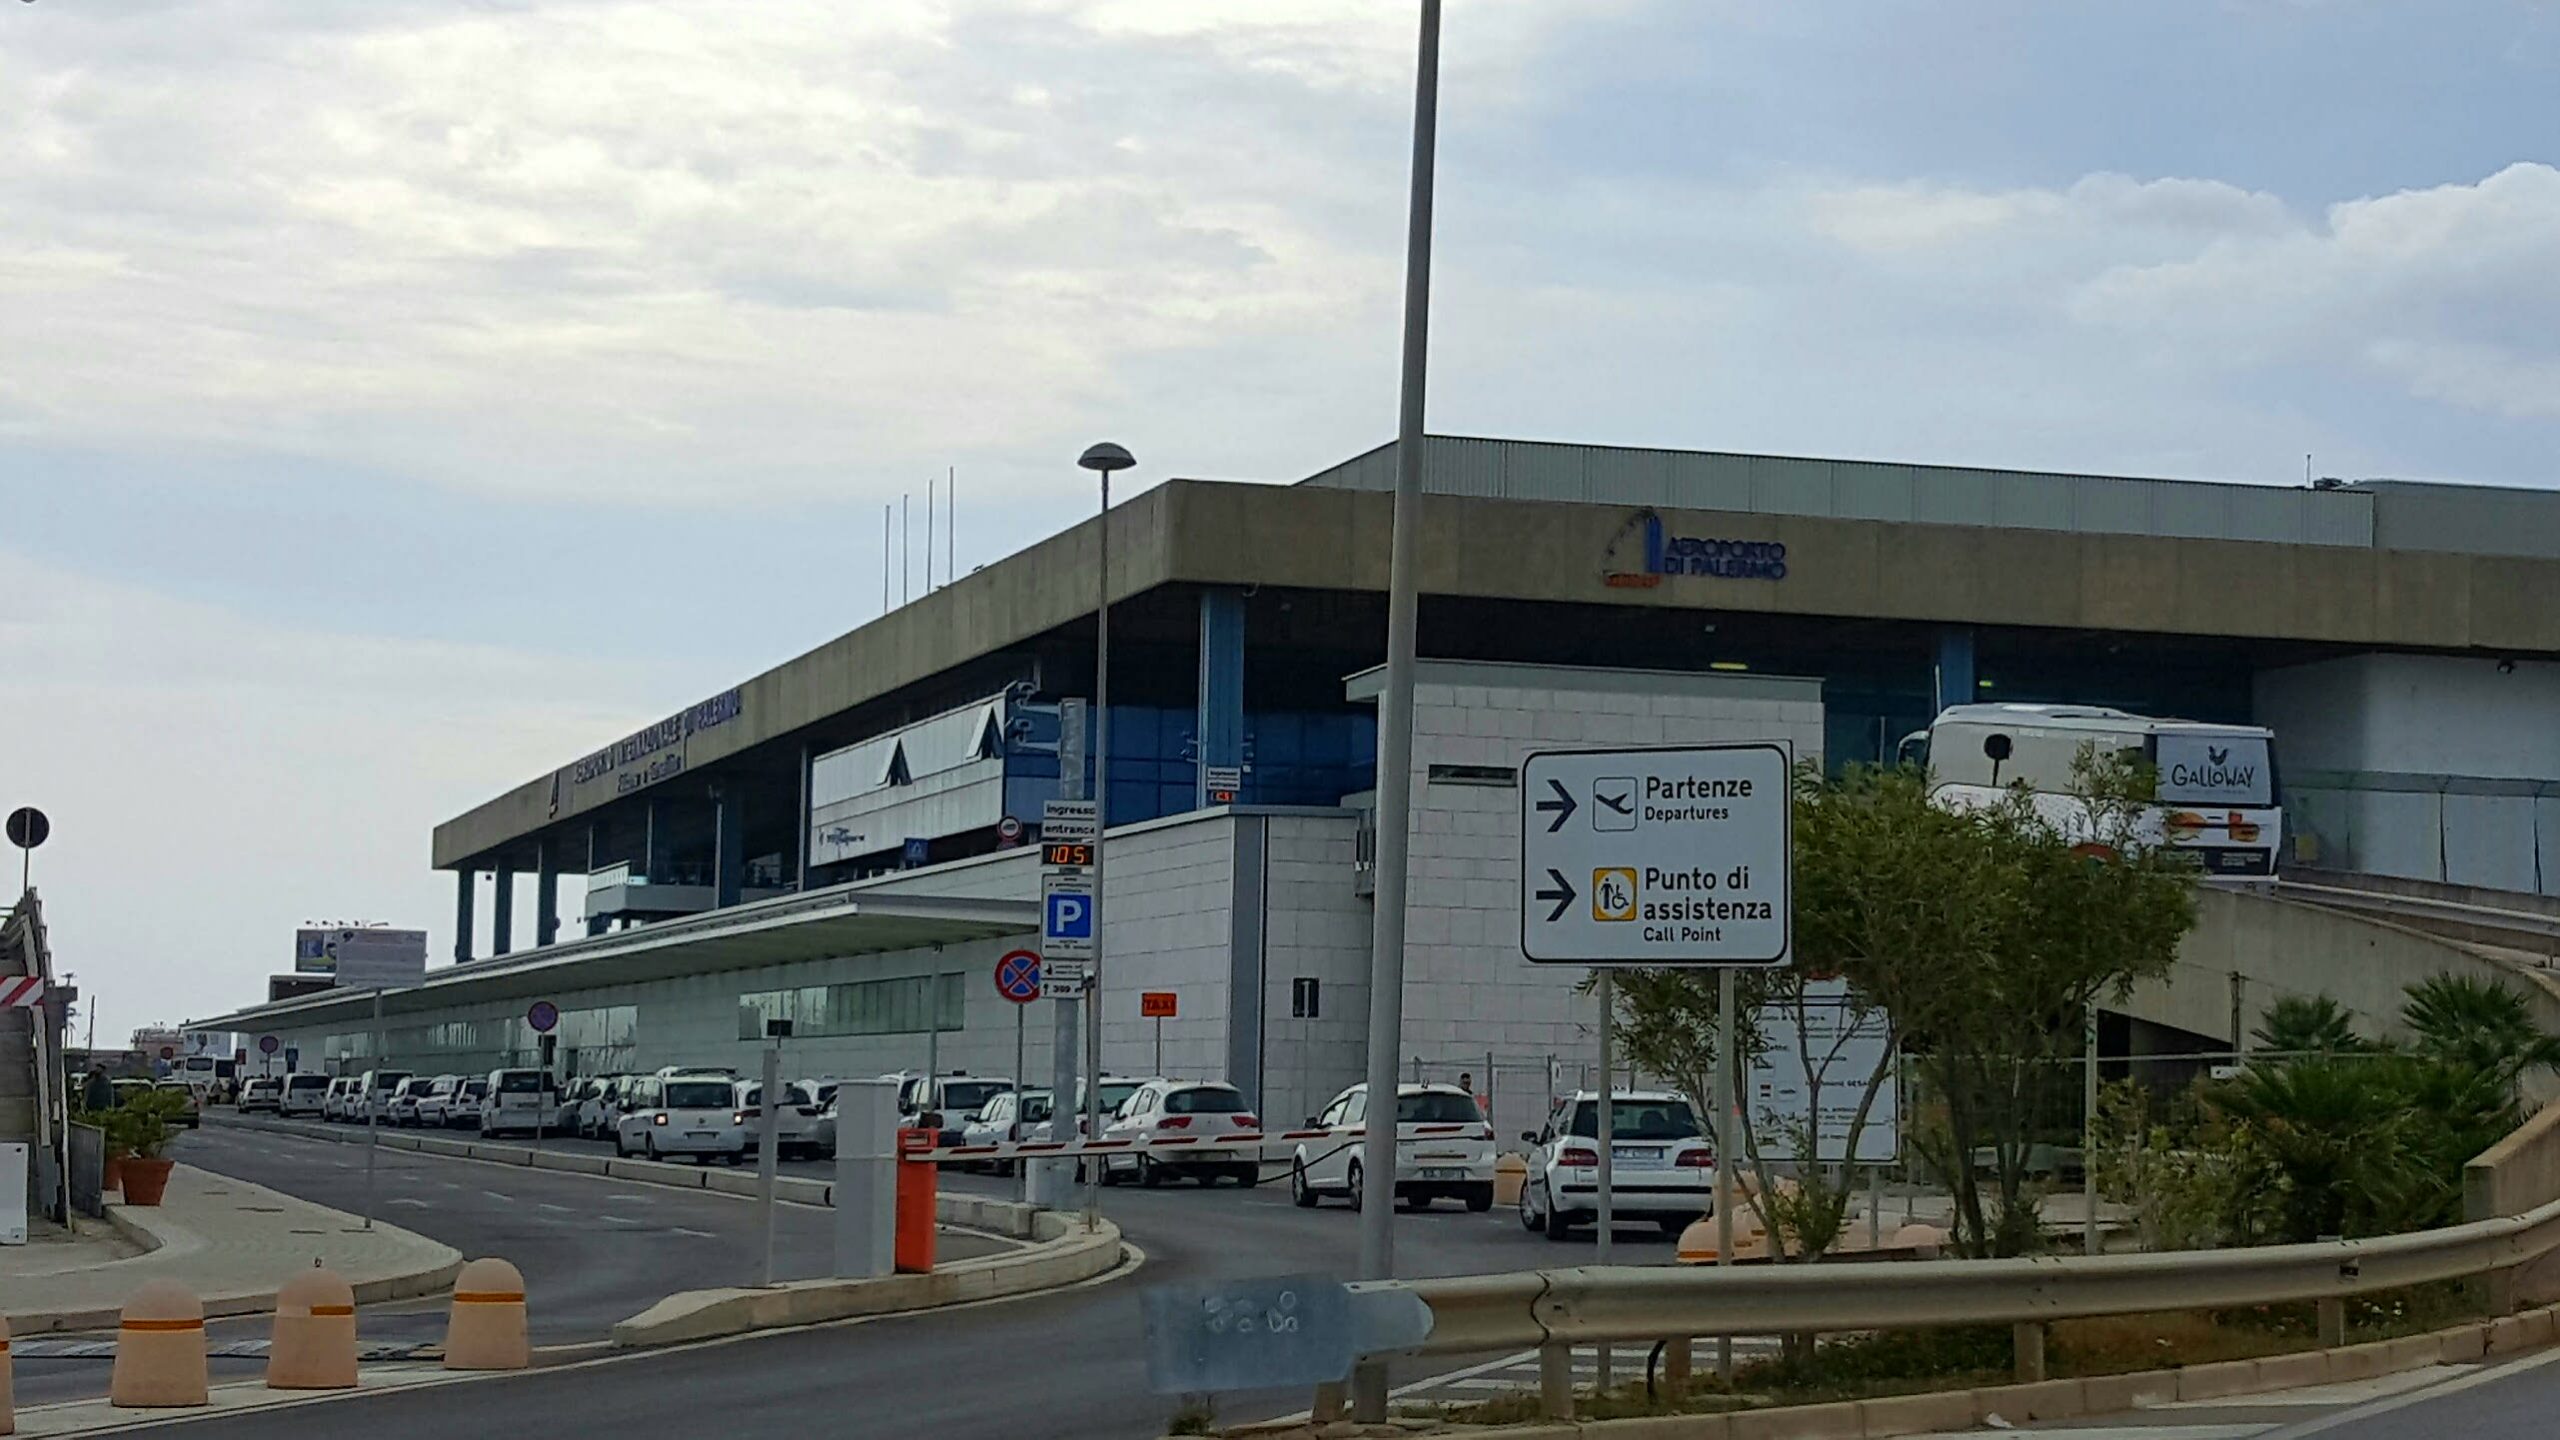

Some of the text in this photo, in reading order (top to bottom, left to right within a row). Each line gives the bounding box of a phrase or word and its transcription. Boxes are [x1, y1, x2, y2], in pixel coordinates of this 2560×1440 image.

[1646, 776, 1753, 799] Partenze
[2171, 764, 2255, 788] GALLOWAY
[1645, 806, 1729, 823] Departures
[1645, 867, 1749, 890] Punto di
[1056, 900, 1082, 933] P
[1644, 897, 1772, 920] assistenza
[1644, 926, 1721, 942] Call Point
[1145, 999, 1175, 1010] TAXI
